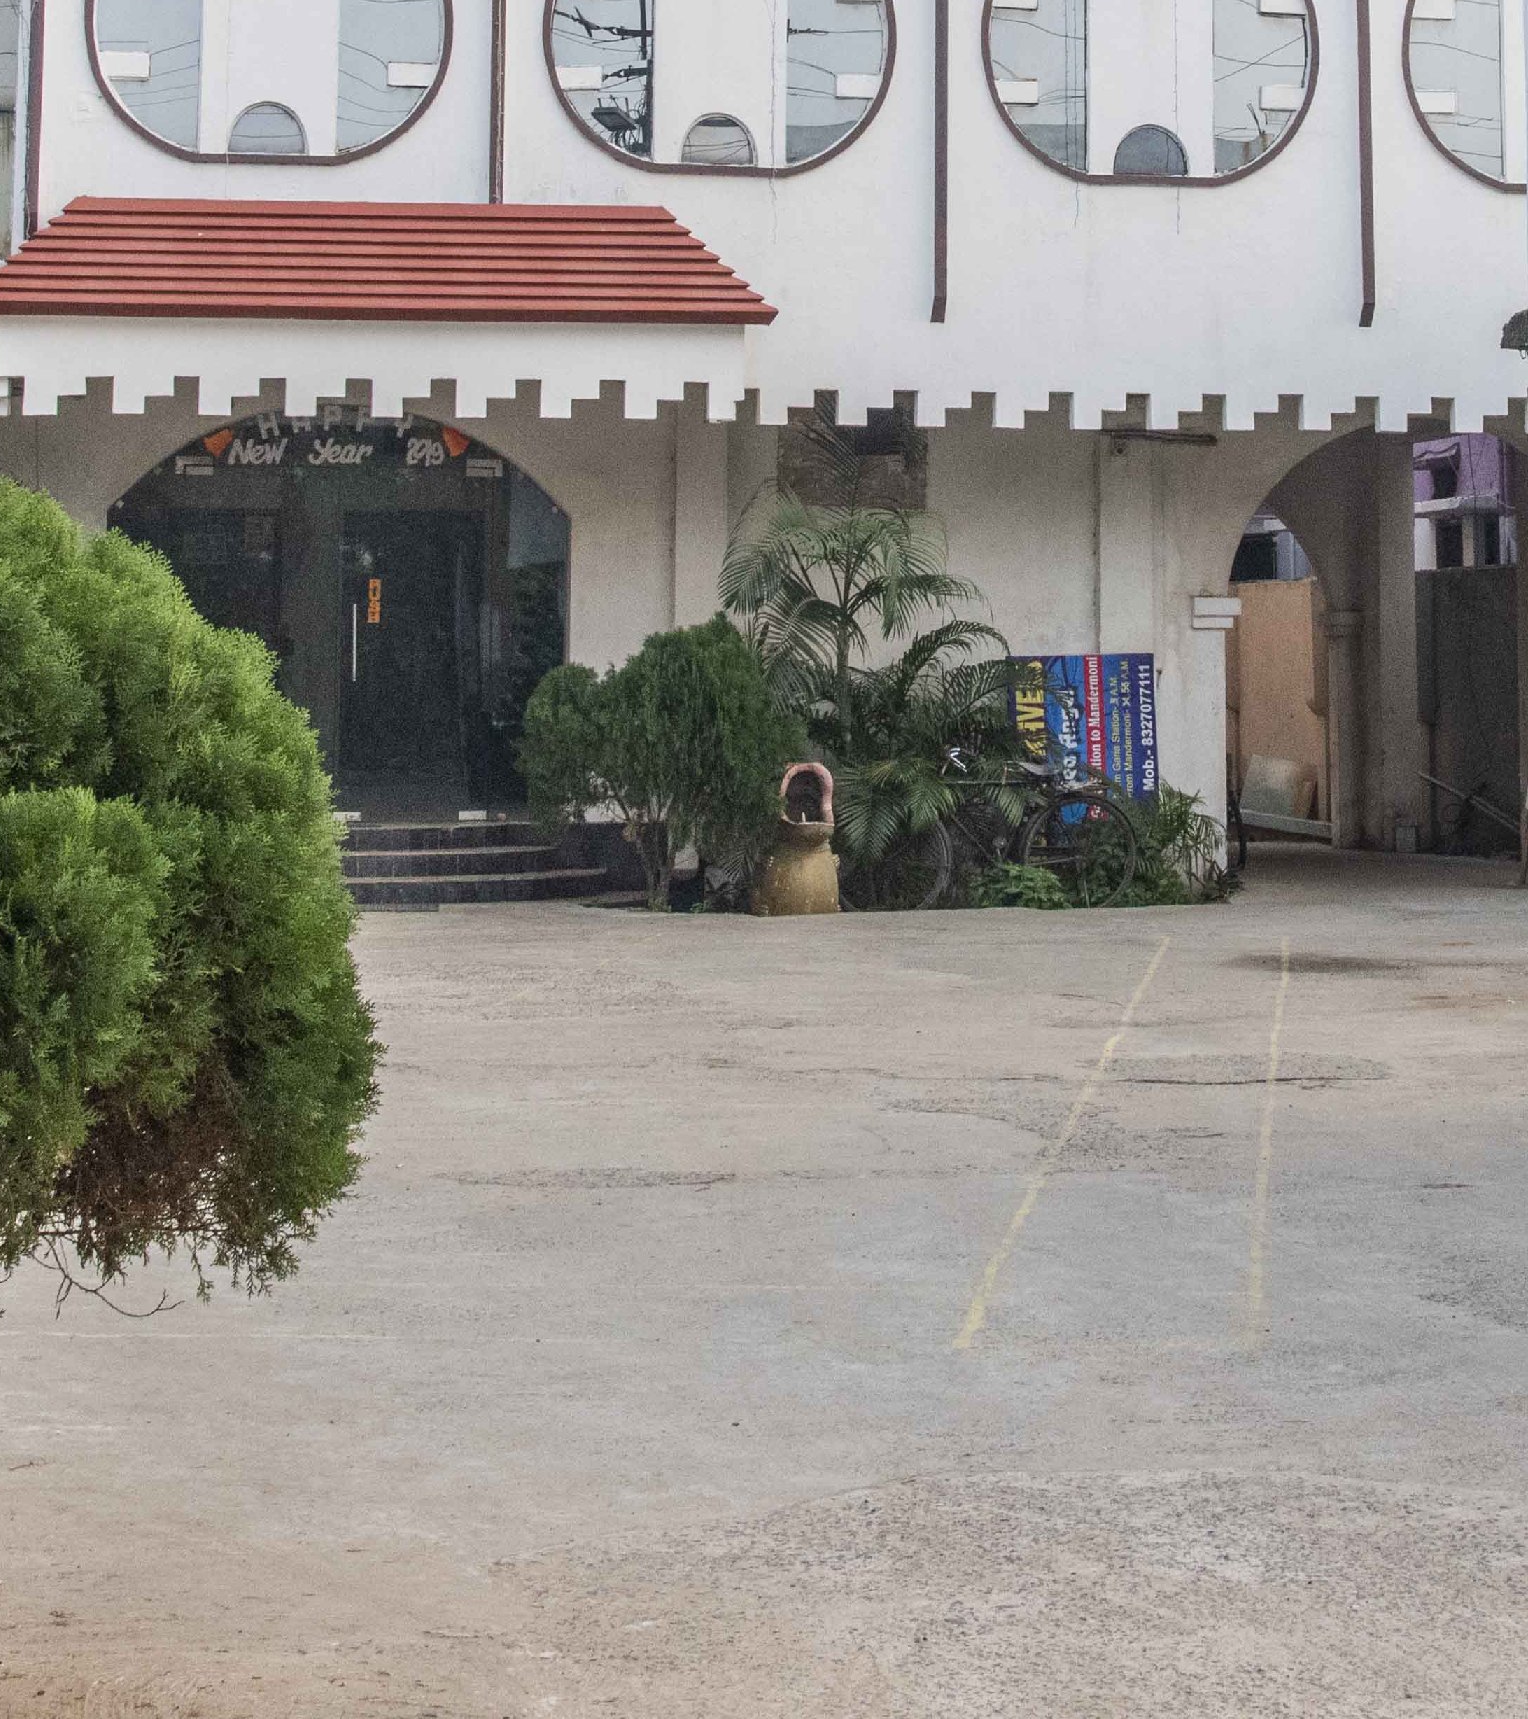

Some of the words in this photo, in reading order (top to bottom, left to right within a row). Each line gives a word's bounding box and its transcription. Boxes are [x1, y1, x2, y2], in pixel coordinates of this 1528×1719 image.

[307, 437, 373, 465] Year
[1086, 657, 1101, 727] Mandermoni
[1138, 665, 1154, 746] 8327077111
[1091, 729, 1101, 741] to
[1142, 749, 1155, 792] Mob.-
